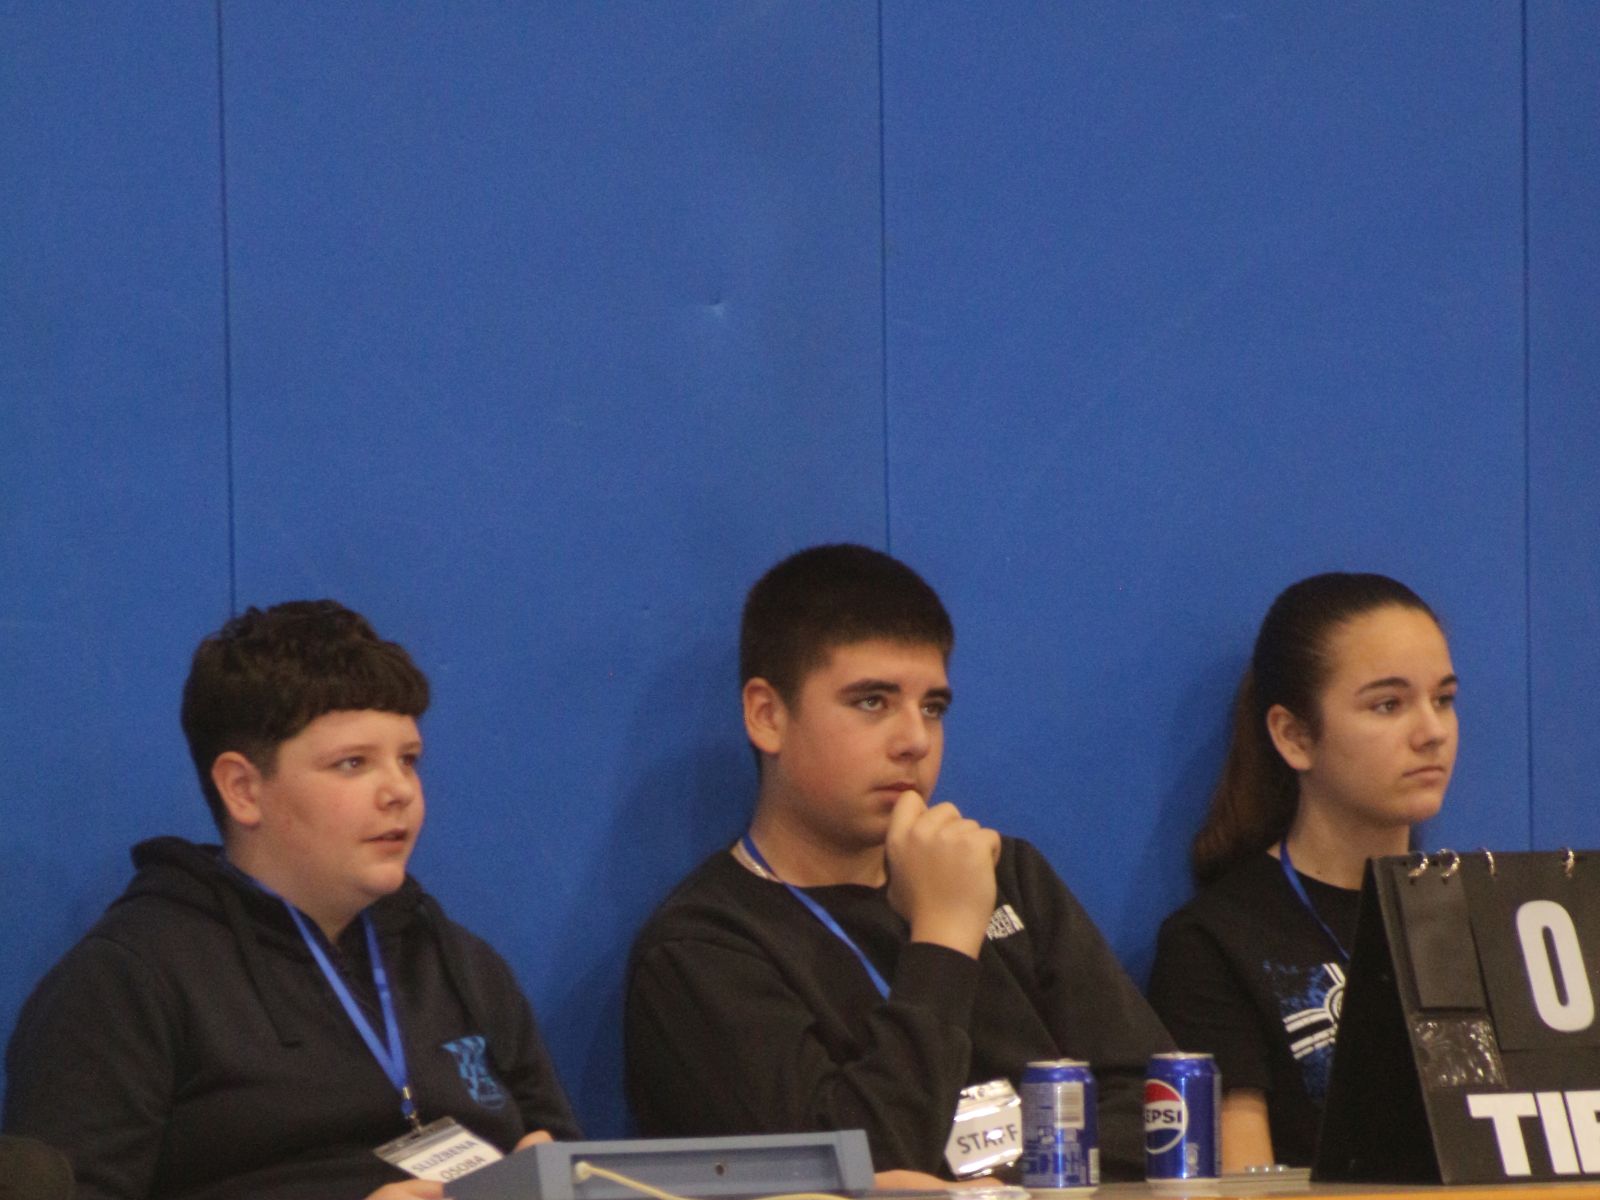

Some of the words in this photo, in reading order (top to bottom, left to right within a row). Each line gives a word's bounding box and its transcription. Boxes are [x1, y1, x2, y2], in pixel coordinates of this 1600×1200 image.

[1516, 900, 1595, 1032] 0
[956, 1123, 1018, 1154] STAFF
[441, 1155, 485, 1179] OSOBA
